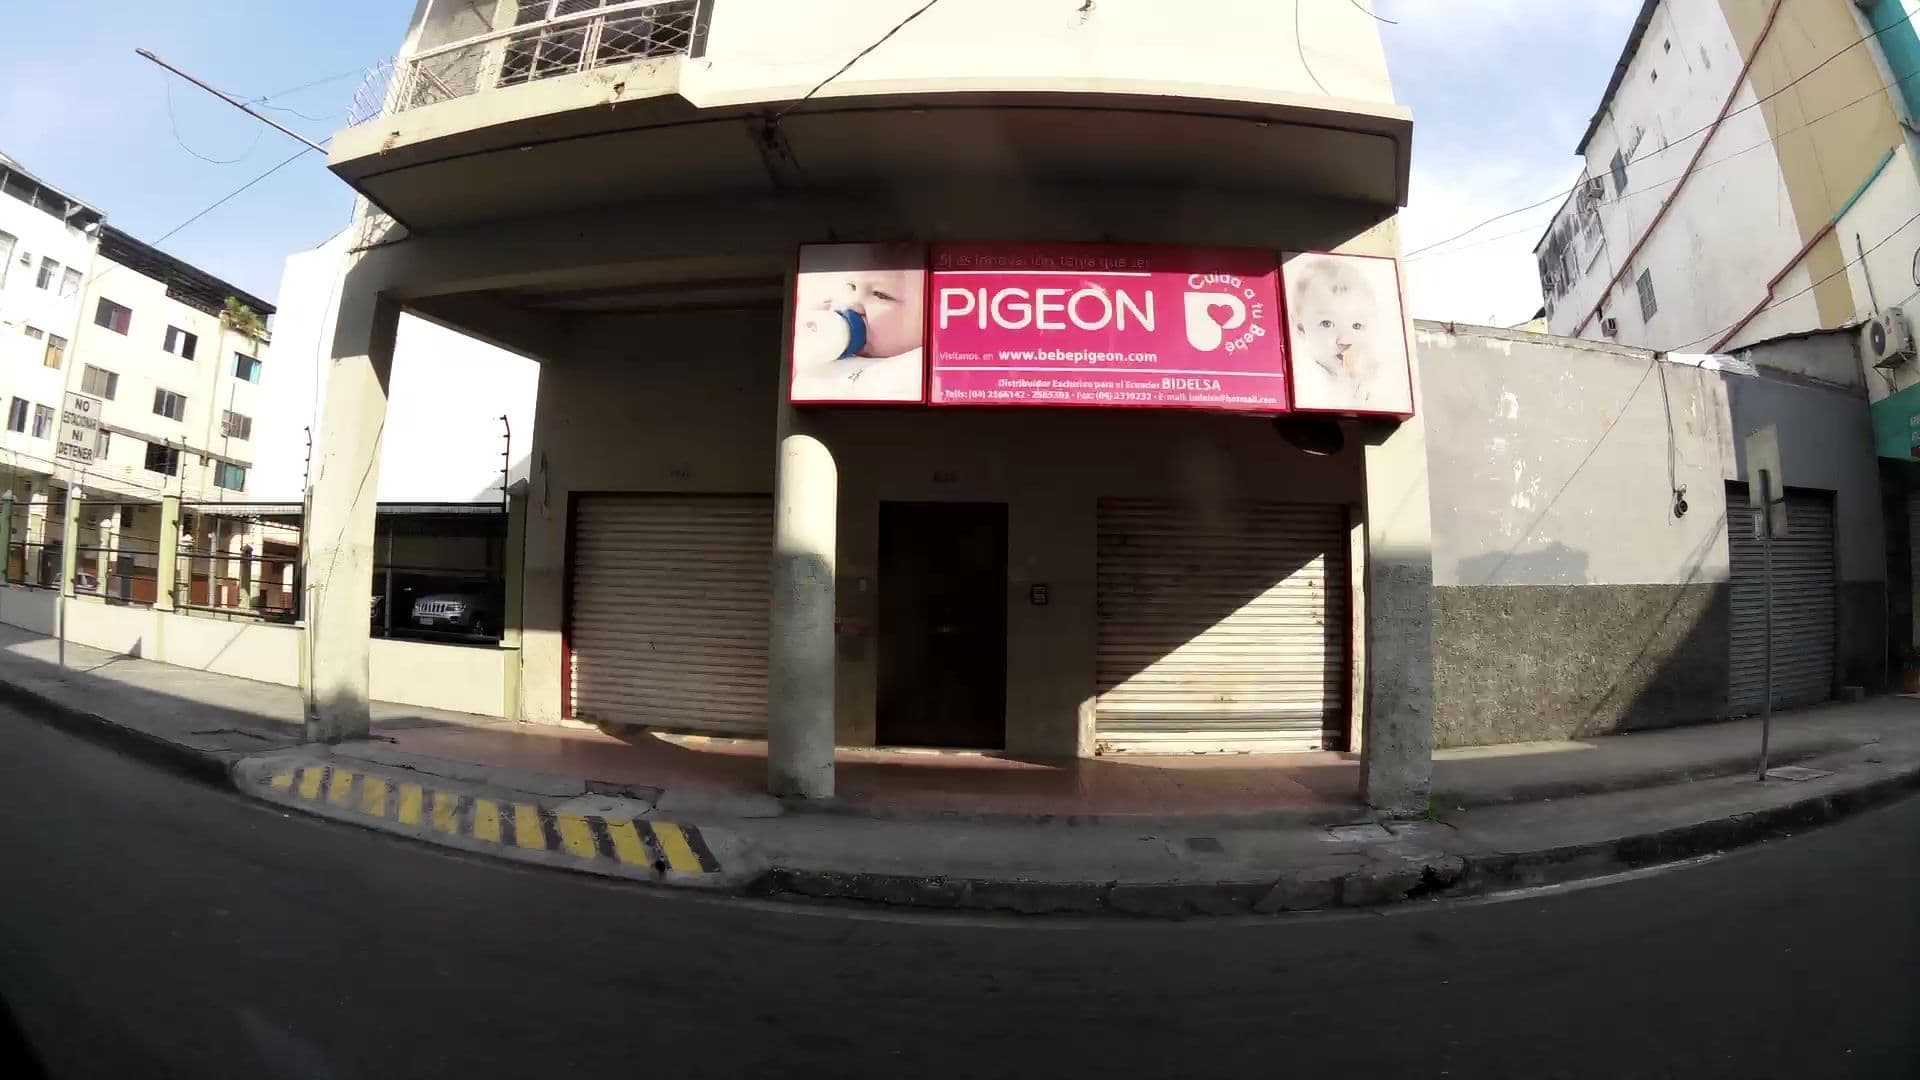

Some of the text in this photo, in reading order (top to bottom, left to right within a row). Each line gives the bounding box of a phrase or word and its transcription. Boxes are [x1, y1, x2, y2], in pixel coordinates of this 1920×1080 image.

[939, 287, 1156, 332] PIGEON
[998, 349, 1158, 364] www.bebepigeon.com
[1161, 377, 1222, 392] BIDELSA
[75, 398, 90, 412] NO
[72, 430, 83, 441] NI
[59, 442, 93, 461] DETENER
